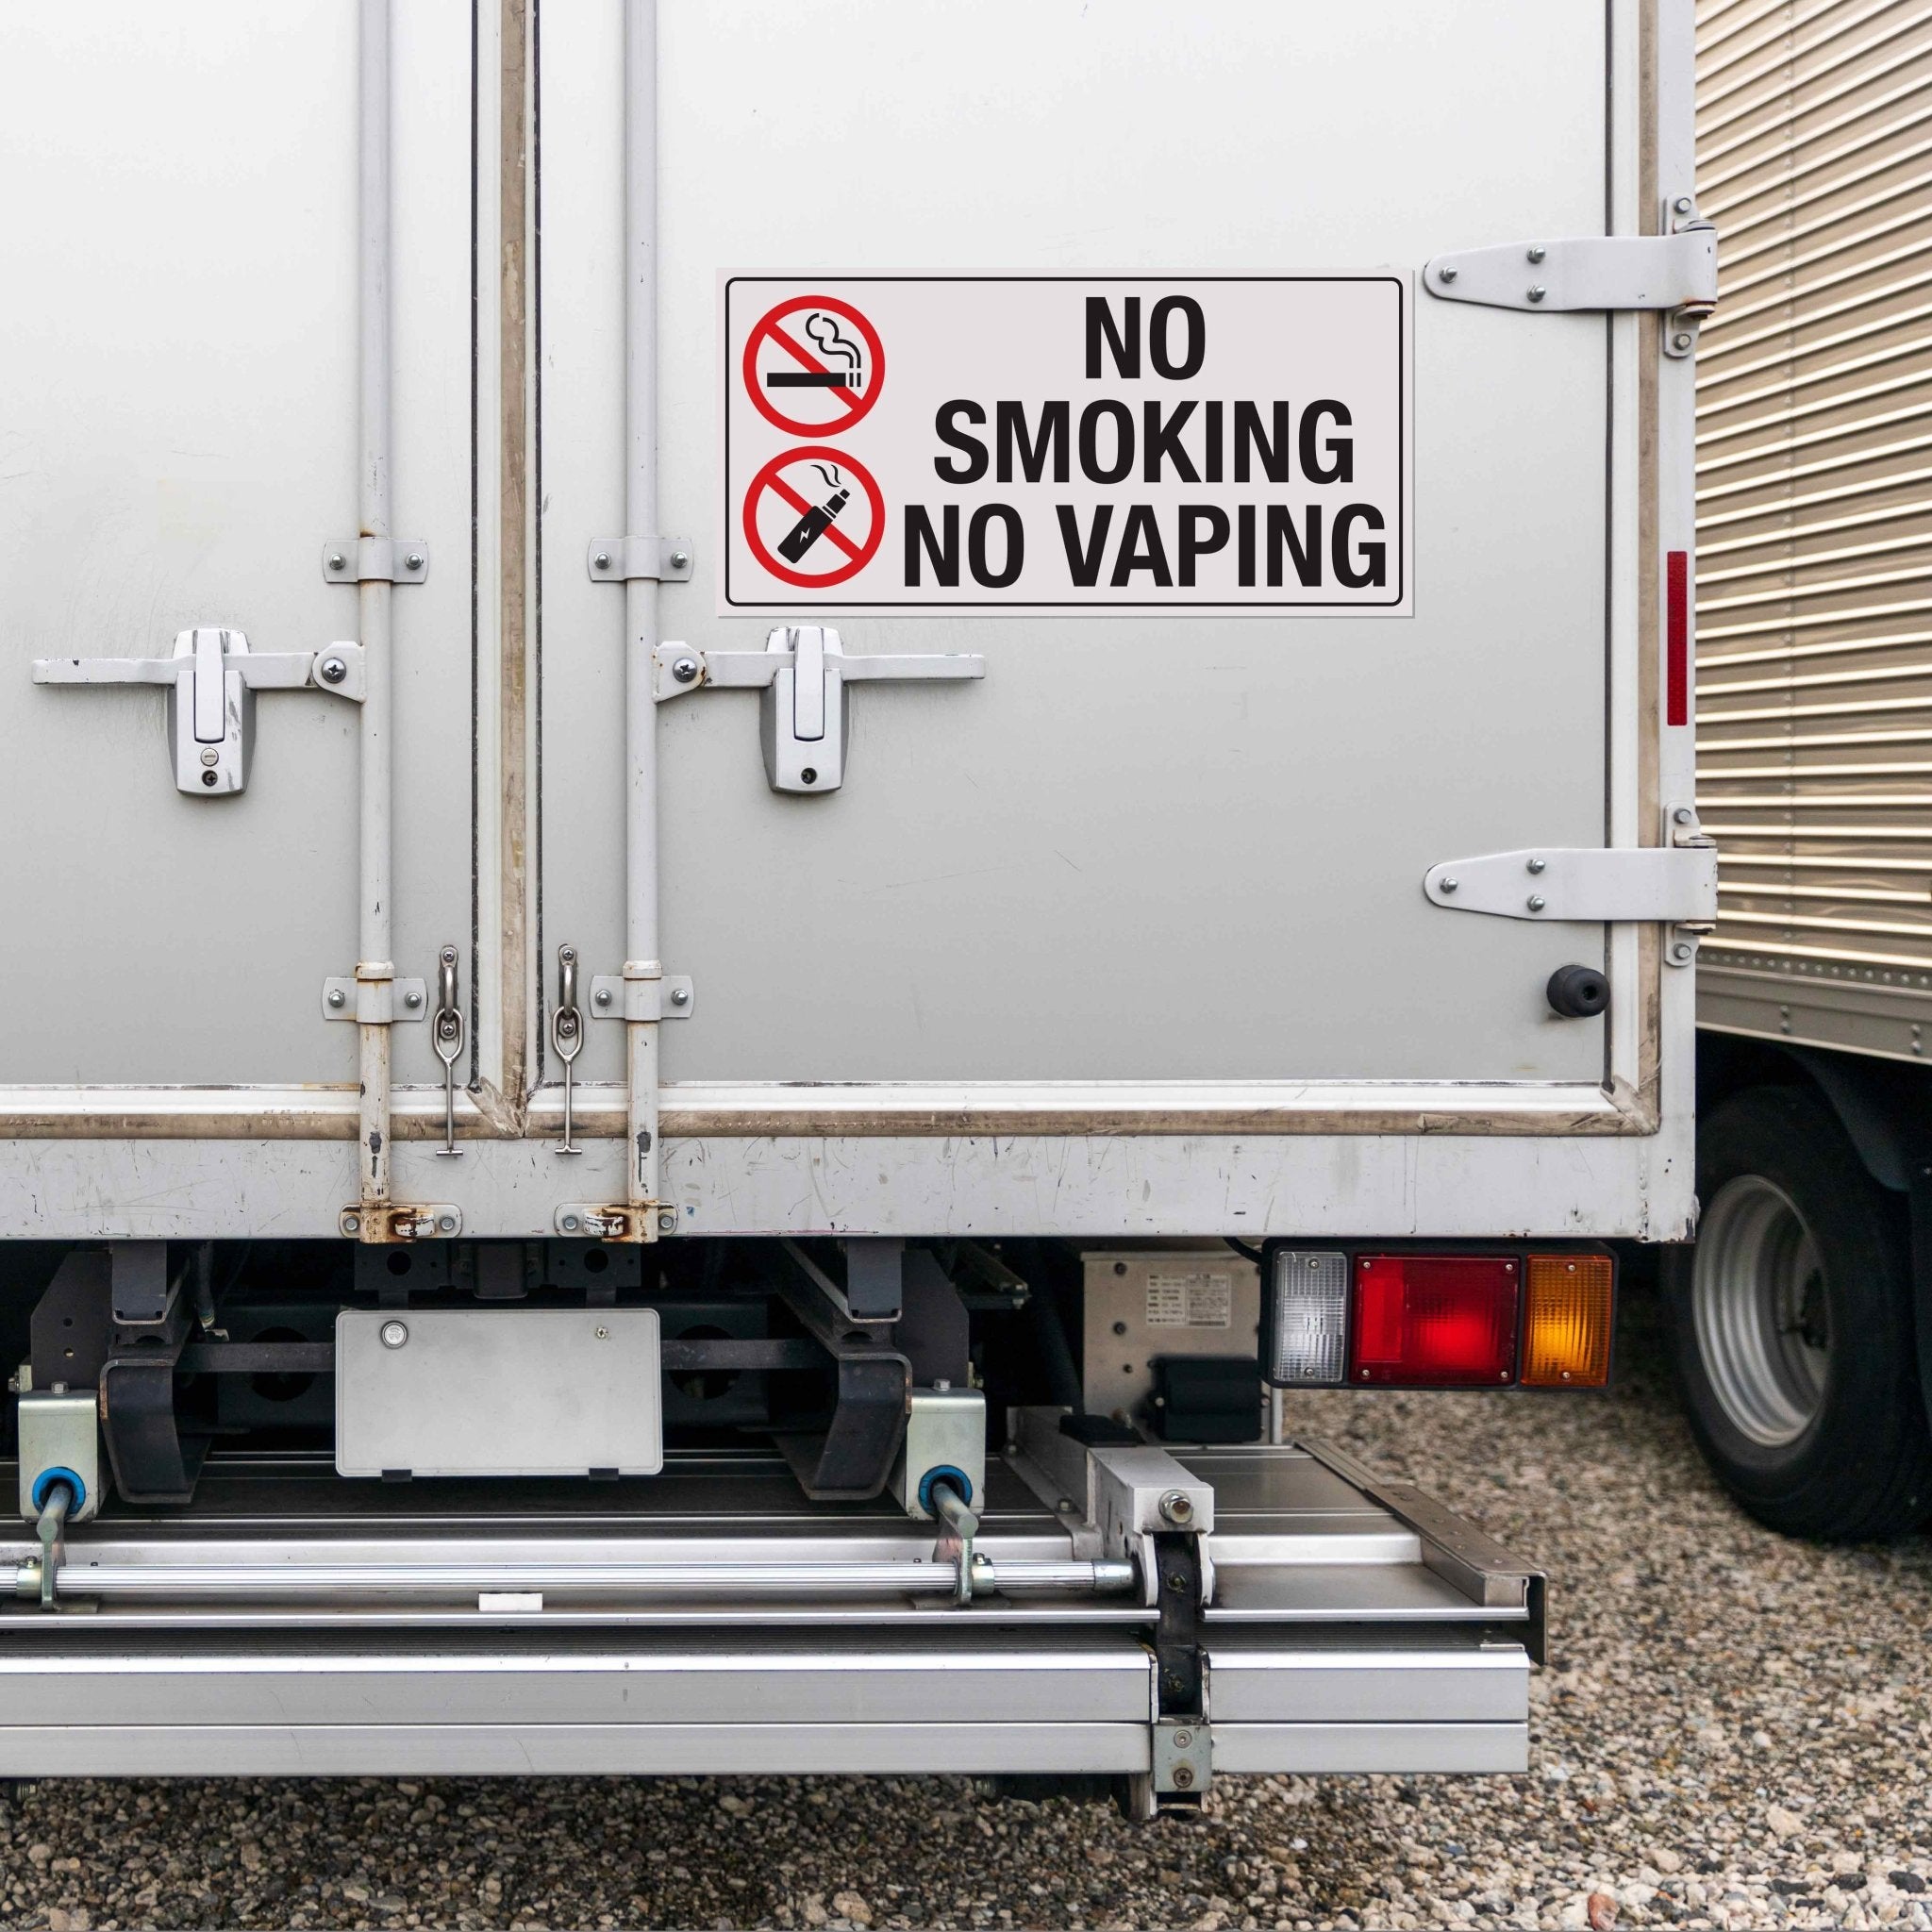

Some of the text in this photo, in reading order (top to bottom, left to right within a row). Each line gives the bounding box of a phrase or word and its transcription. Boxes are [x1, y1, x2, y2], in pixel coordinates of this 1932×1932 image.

[1086, 295, 1206, 380] NO
[934, 399, 1354, 484] SMOKING
[904, 503, 1387, 588] NO VAPING
